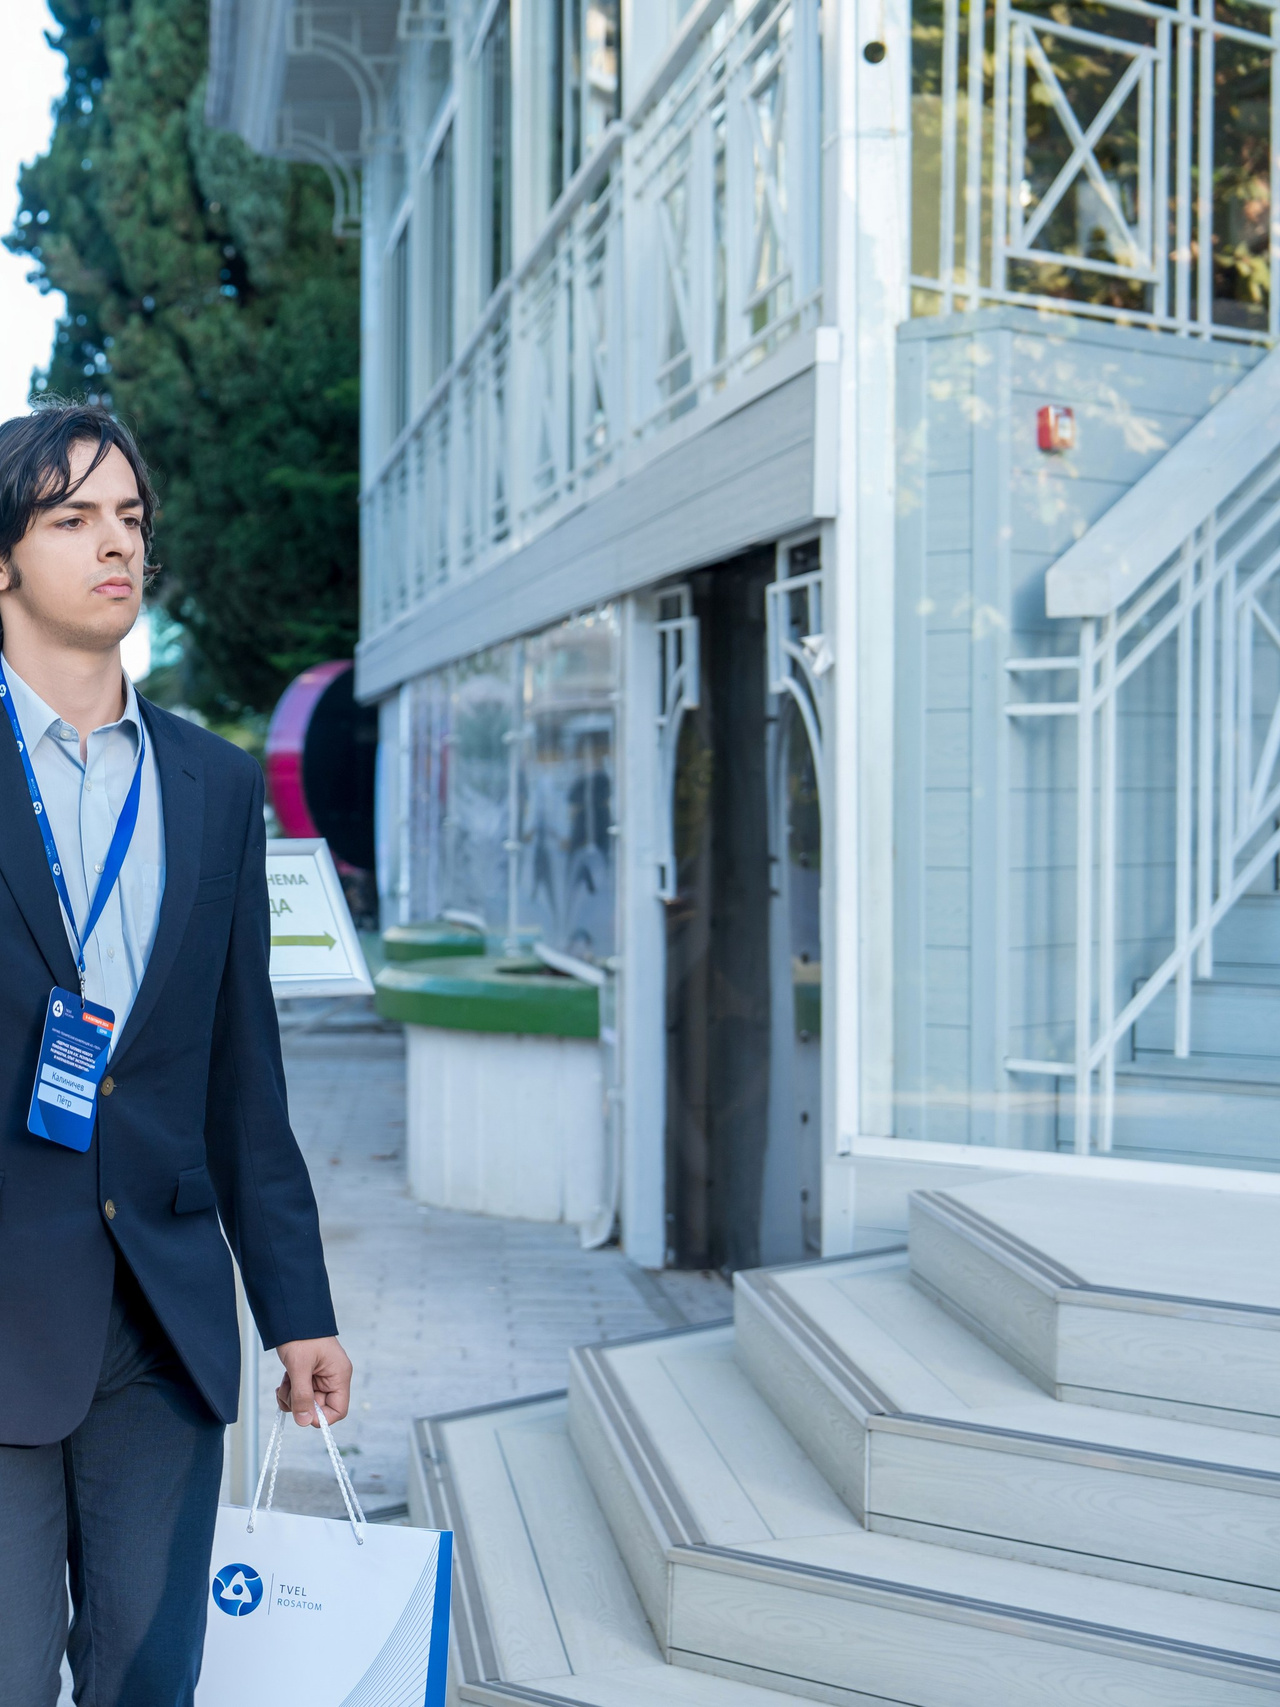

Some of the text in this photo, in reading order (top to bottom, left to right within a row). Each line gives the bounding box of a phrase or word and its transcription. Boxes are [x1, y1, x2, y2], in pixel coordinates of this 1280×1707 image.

[51, 1071, 85, 1092] Калиничев
[56, 1093, 72, 1109] Пётр
[279, 1584, 308, 1597] TVEL
[276, 1597, 322, 1611] ROSATOM
